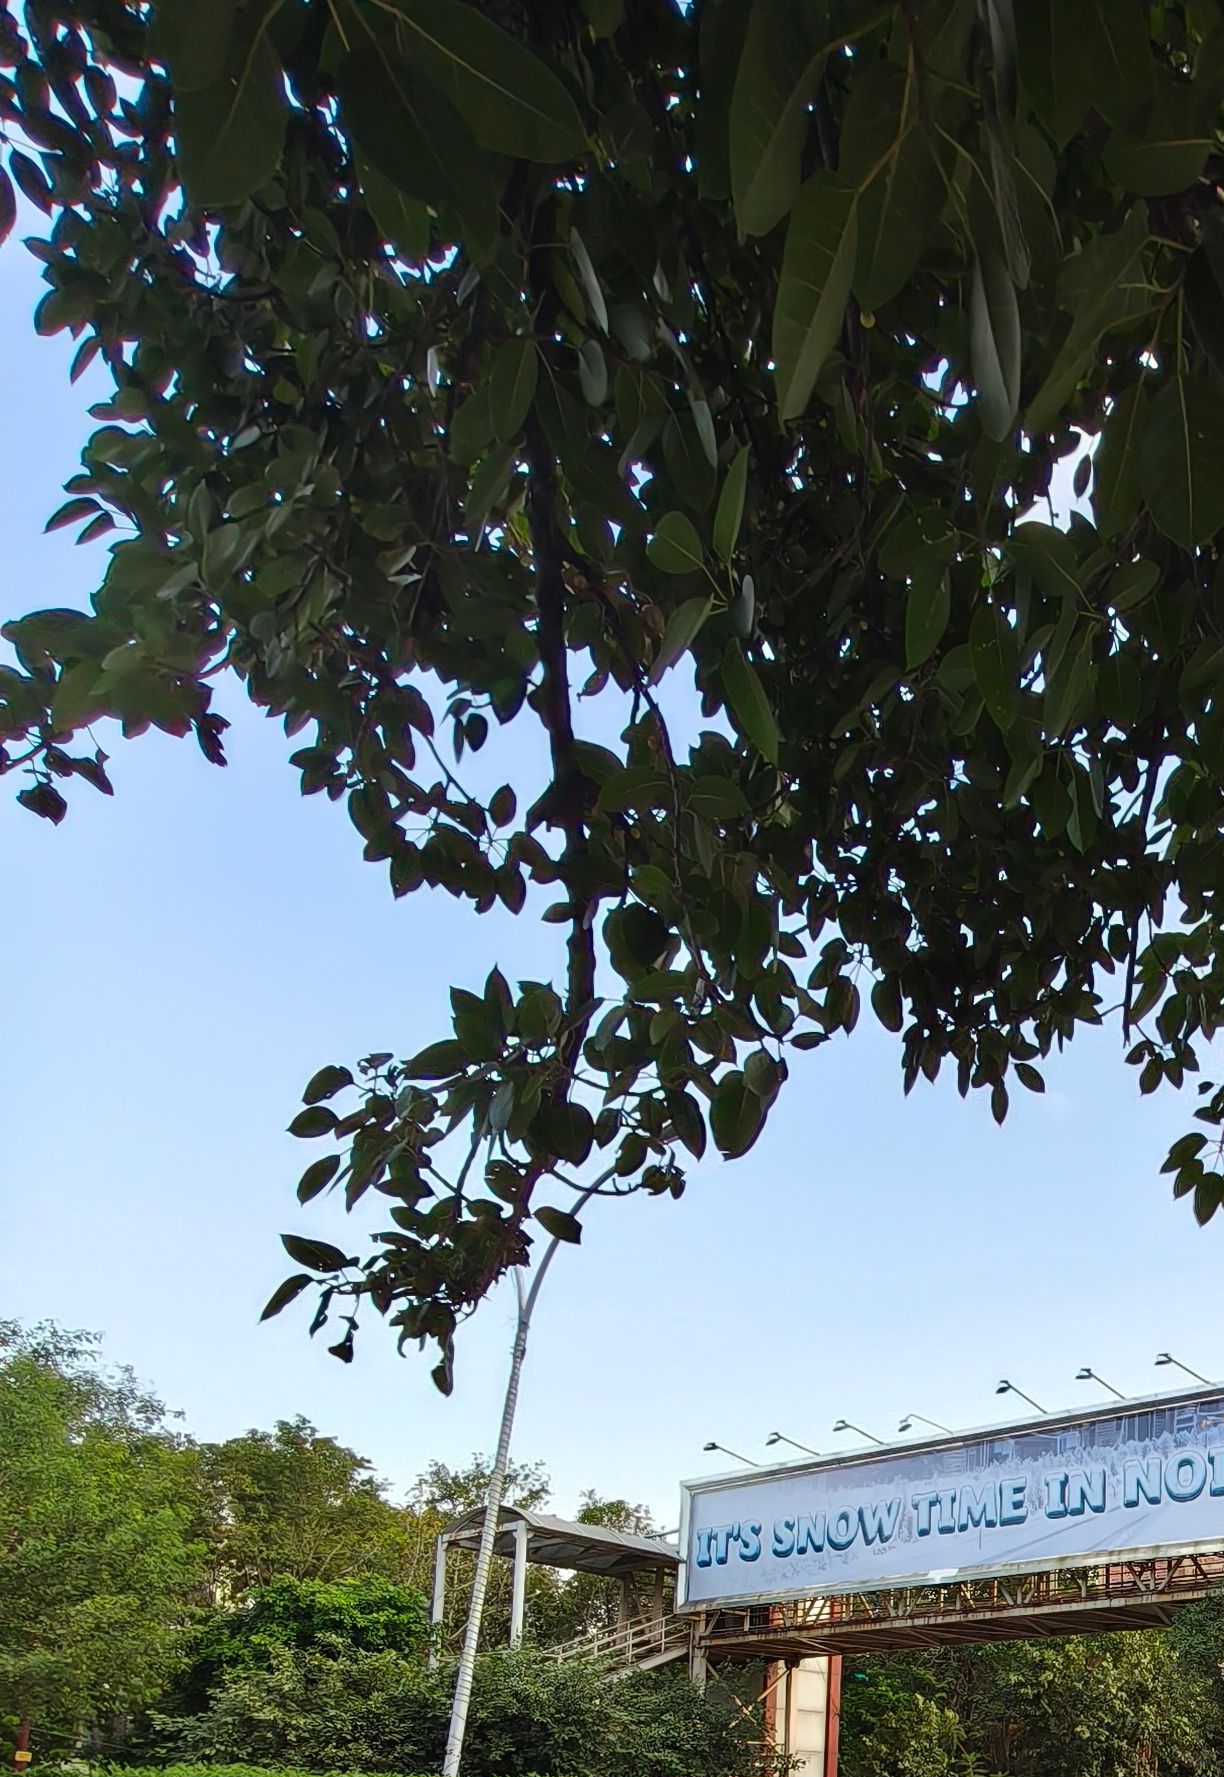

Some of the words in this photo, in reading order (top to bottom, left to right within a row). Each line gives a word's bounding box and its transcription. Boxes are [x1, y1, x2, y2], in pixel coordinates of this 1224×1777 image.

[697, 1518, 762, 1567] IT'S
[772, 1497, 902, 1558] SNOW
[910, 1476, 1028, 1536] TIME
[1044, 1466, 1107, 1518] IN
